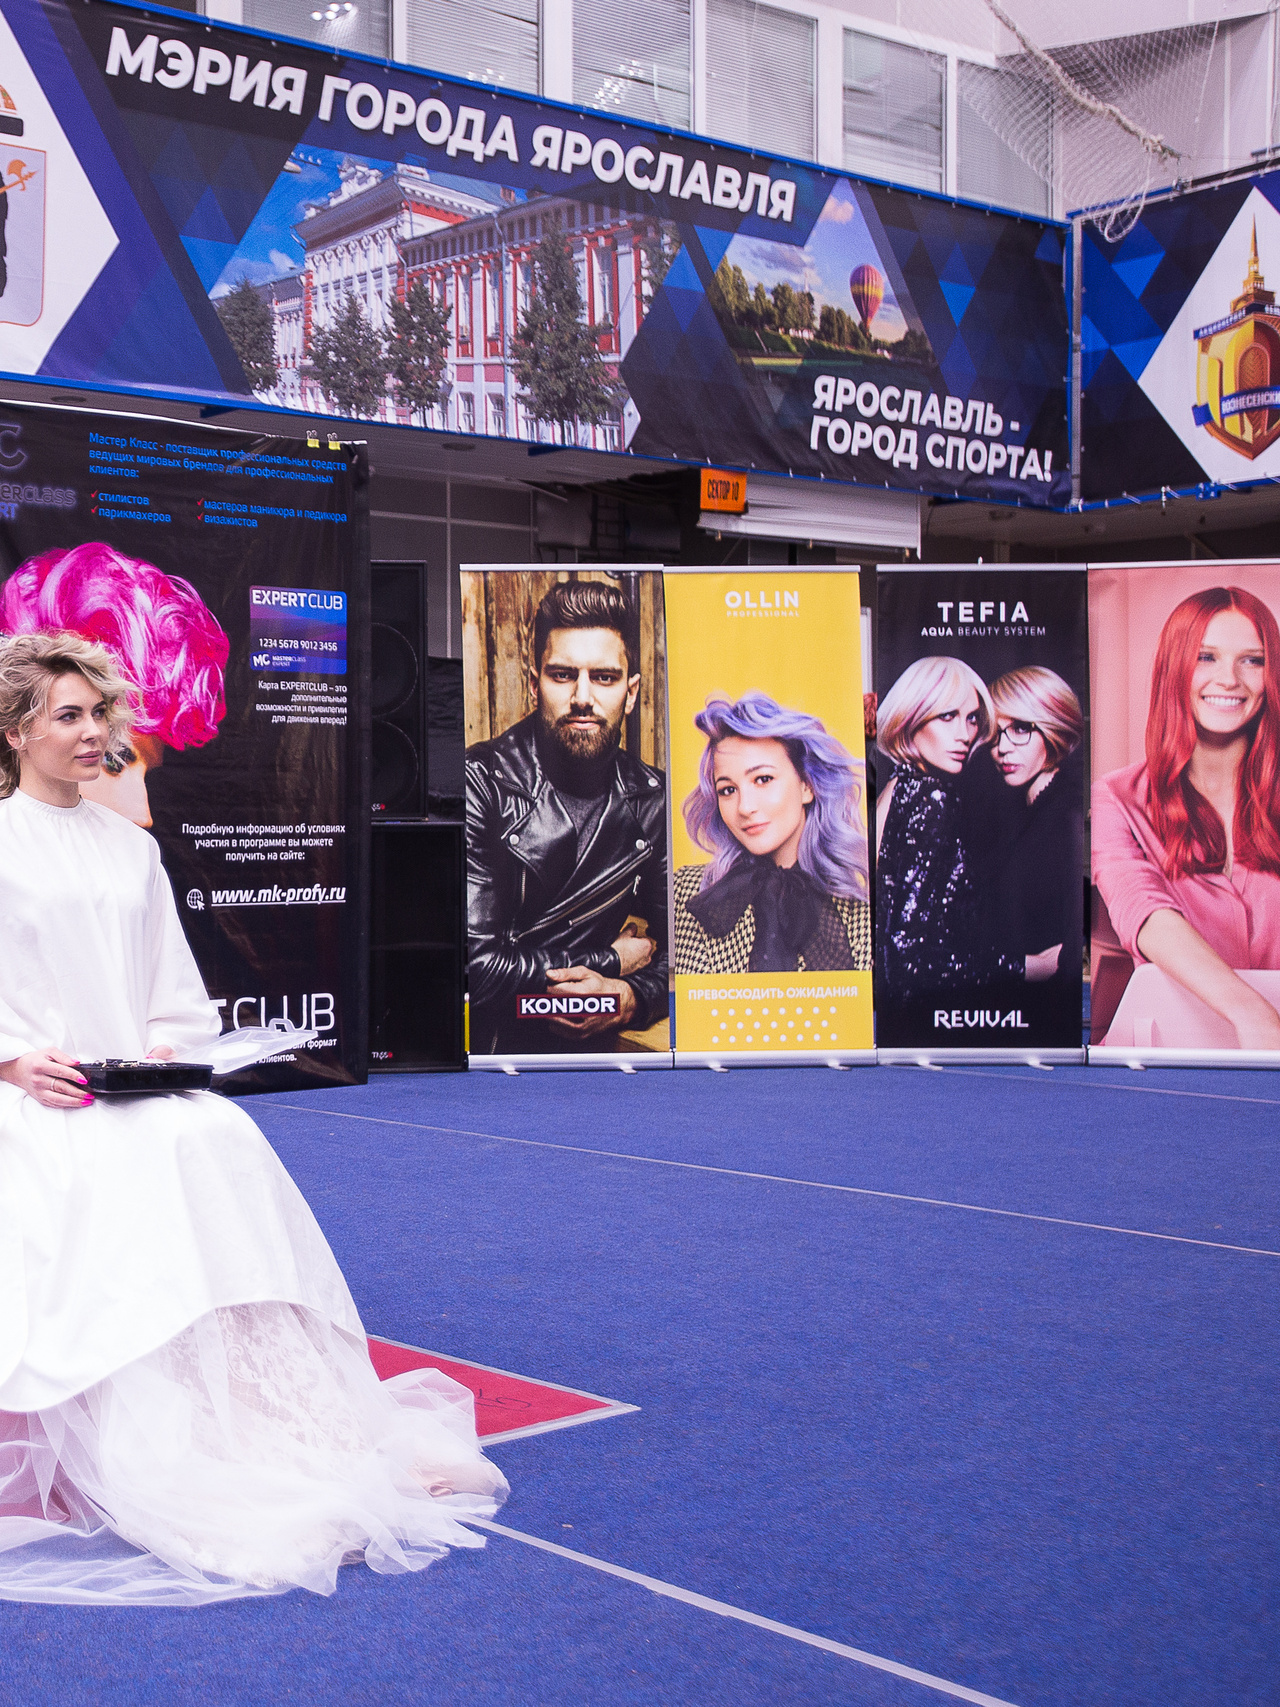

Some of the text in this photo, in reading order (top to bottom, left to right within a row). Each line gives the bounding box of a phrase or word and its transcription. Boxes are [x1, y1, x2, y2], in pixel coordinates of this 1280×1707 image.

[104, 26, 796, 223] МЭРИЯ ГОРОДА ЯРОСЛАВЛЯ
[812, 375, 1004, 436] ЯРОСЛАВЛЬ
[89, 432, 127, 449] Мастер
[129, 437, 158, 450] Класс
[166, 443, 218, 458] поставщик
[220, 449, 310, 467] профессиональных
[311, 459, 347, 472] средств
[810, 415, 1053, 482] ГОРОД СПОРТА!
[89, 450, 334, 484] ведущих мировых брендов для профессиональных
[89, 465, 140, 478] клиентов:
[98, 492, 150, 505] стилистов
[732, 481, 739, 501] 10
[204, 500, 248, 514] мастеров
[98, 507, 171, 523] парикмахеров
[204, 515, 258, 528] визажистов
[252, 589, 343, 610] EXPERTCLUB
[724, 590, 799, 609] OLLIN
[937, 601, 1029, 623] TEFIA
[921, 626, 1046, 636] AQUA BEAUTY SYSTEM
[259, 638, 338, 652] 1234 5678 9012 3456
[258, 680, 279, 690] Карта
[280, 681, 328, 692] EXPERTCLUB
[256, 704, 301, 712] возможности
[308, 705, 347, 714] привилегии
[272, 715, 286, 724] для
[182, 823, 346, 836] Подробную информацию об условиях
[195, 838, 229, 849] участия
[239, 838, 286, 849] программе
[288, 838, 300, 846] вы
[302, 838, 333, 846] можете
[225, 850, 305, 863] получить на сайте:
[211, 883, 346, 906] www.mk-profy.ru
[688, 985, 858, 1000] ПРЕВОСХОДИТЬ ОЖИДАНИЯ
[521, 997, 616, 1014] KONDOR
[934, 1010, 1029, 1029] REVIVAL
[307, 1038, 337, 1050] формат
